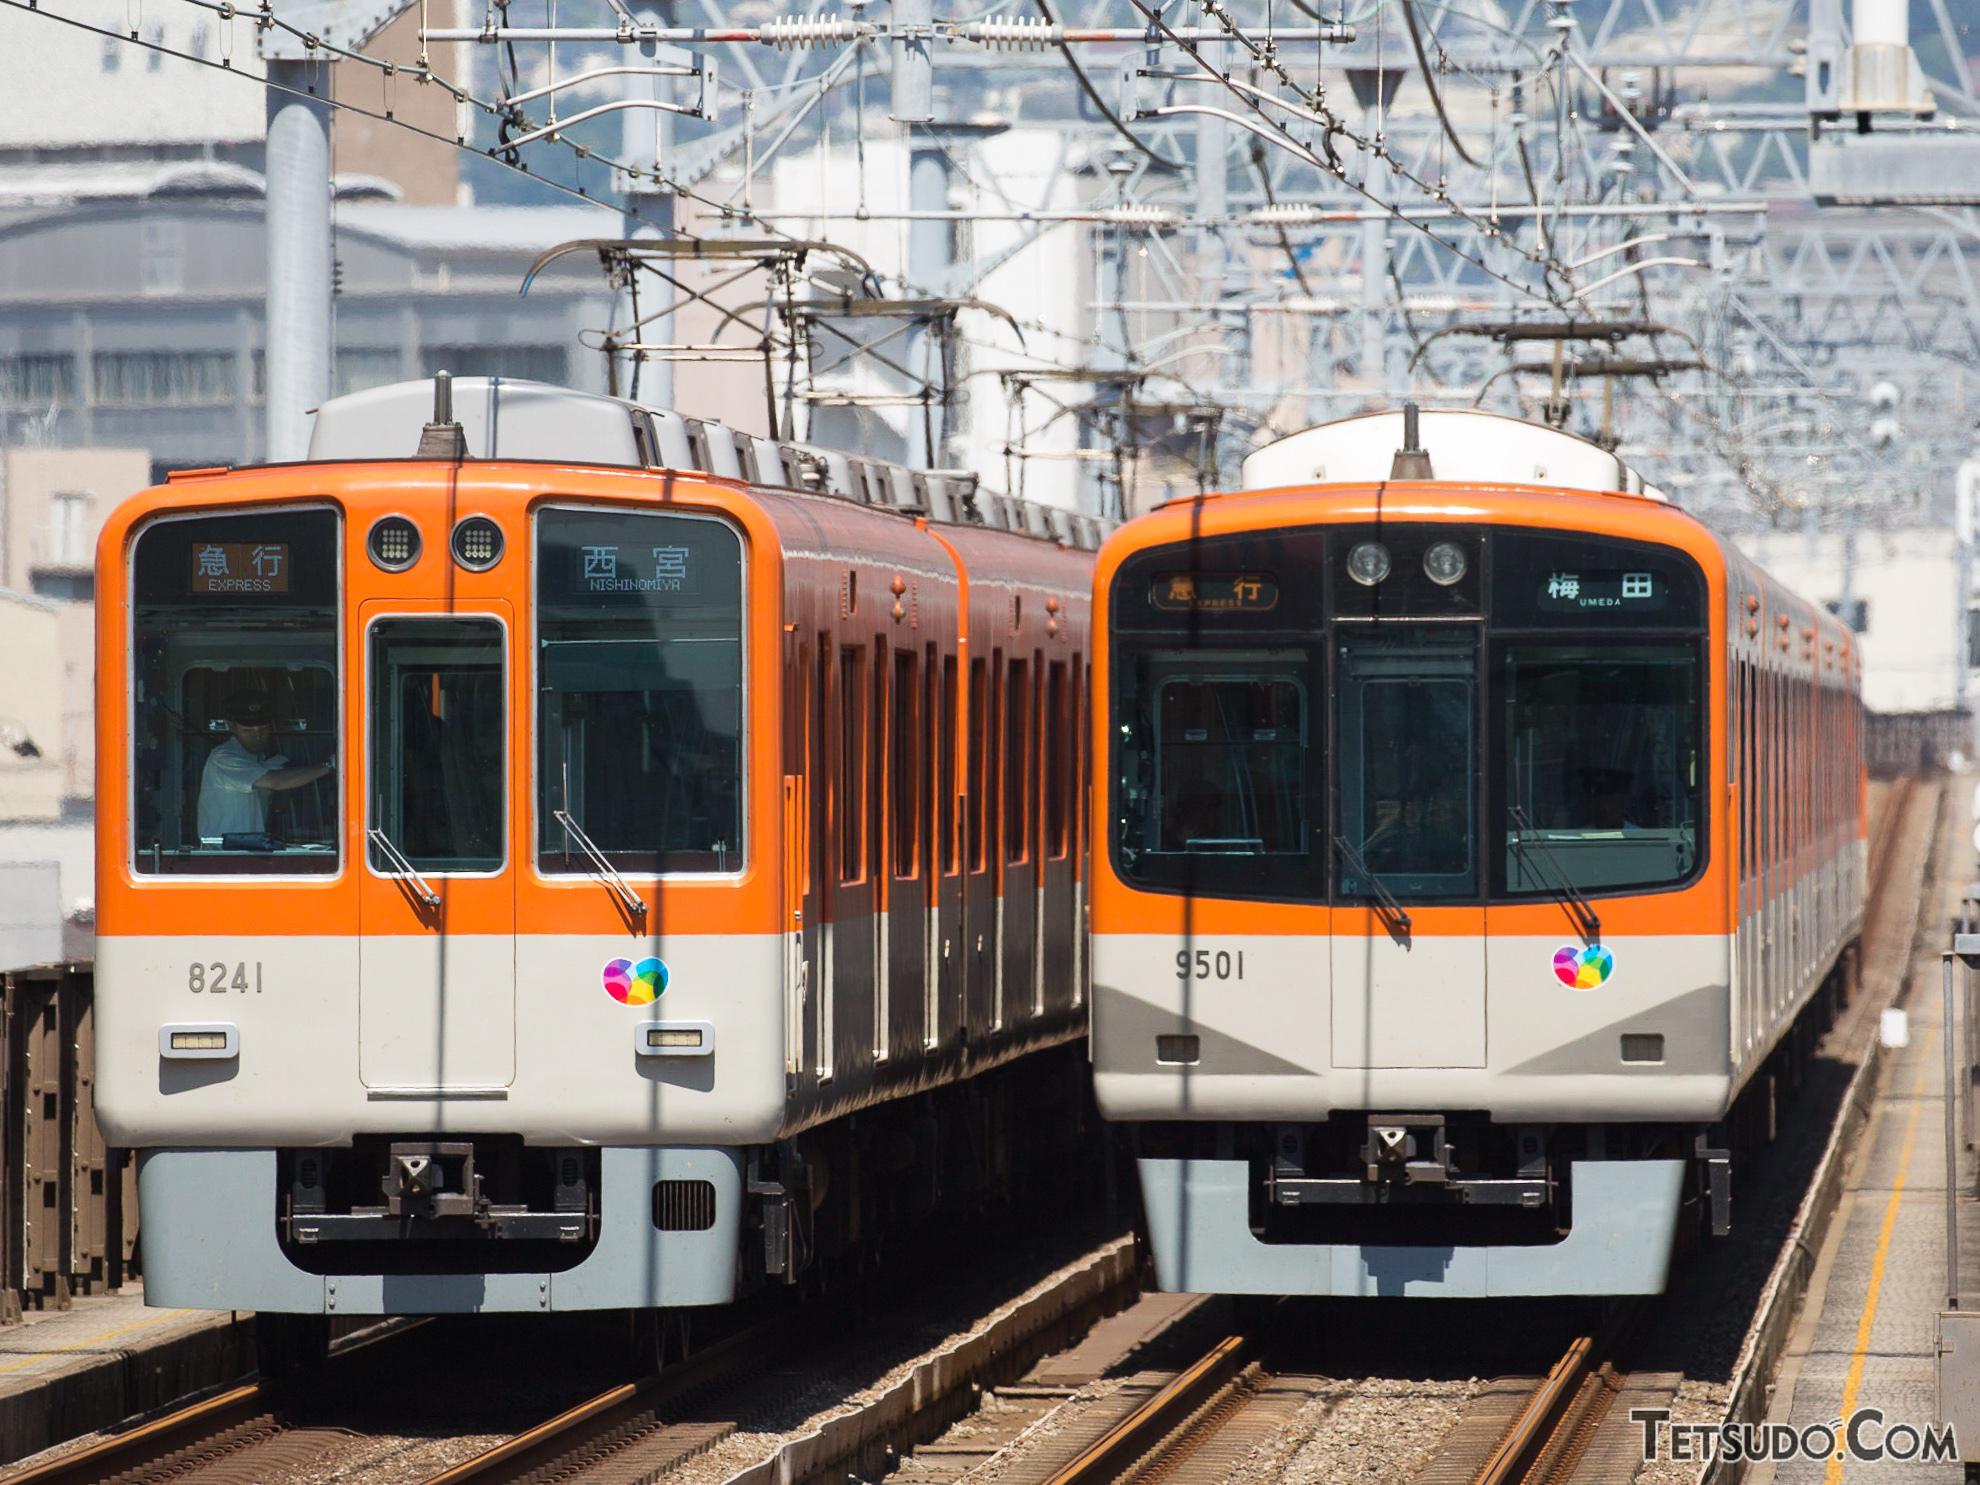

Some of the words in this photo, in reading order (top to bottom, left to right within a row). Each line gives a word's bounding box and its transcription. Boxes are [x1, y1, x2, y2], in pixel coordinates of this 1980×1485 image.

[198, 544, 283, 576] 急行
[581, 545, 689, 578] 西宮
[208, 579, 271, 591] EXPRESS
[590, 579, 681, 591] NISHINOMIYA
[1548, 572, 1652, 599] 梅田
[1579, 598, 1621, 607] UMEDA
[188, 961, 262, 993] 8241
[1175, 950, 1243, 980] 9501
